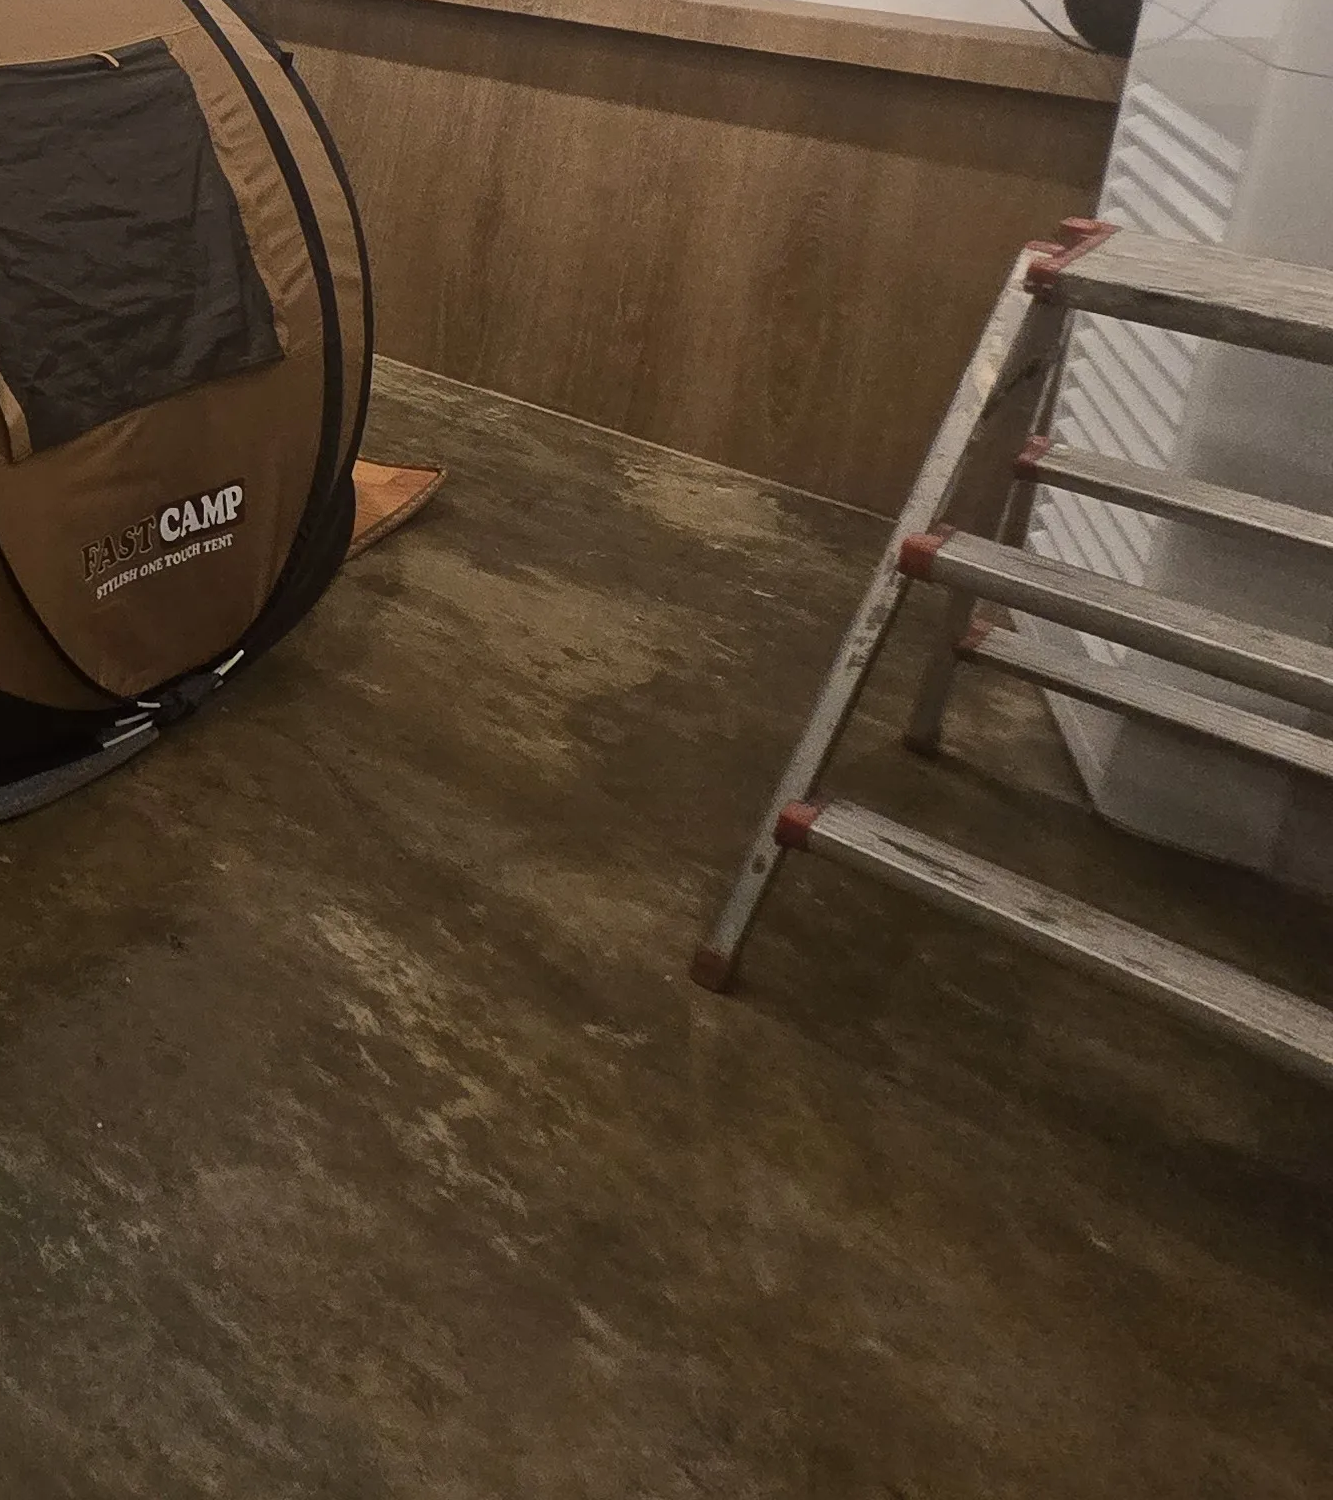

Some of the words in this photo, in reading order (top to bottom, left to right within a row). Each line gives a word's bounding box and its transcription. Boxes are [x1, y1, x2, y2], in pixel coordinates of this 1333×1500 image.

[81, 515, 157, 582] FAST
[159, 485, 243, 542] CAMP
[96, 567, 138, 600] STYLISH
[139, 557, 164, 577] ONE
[164, 542, 201, 567] TOUCH
[203, 533, 234, 553] TENT
